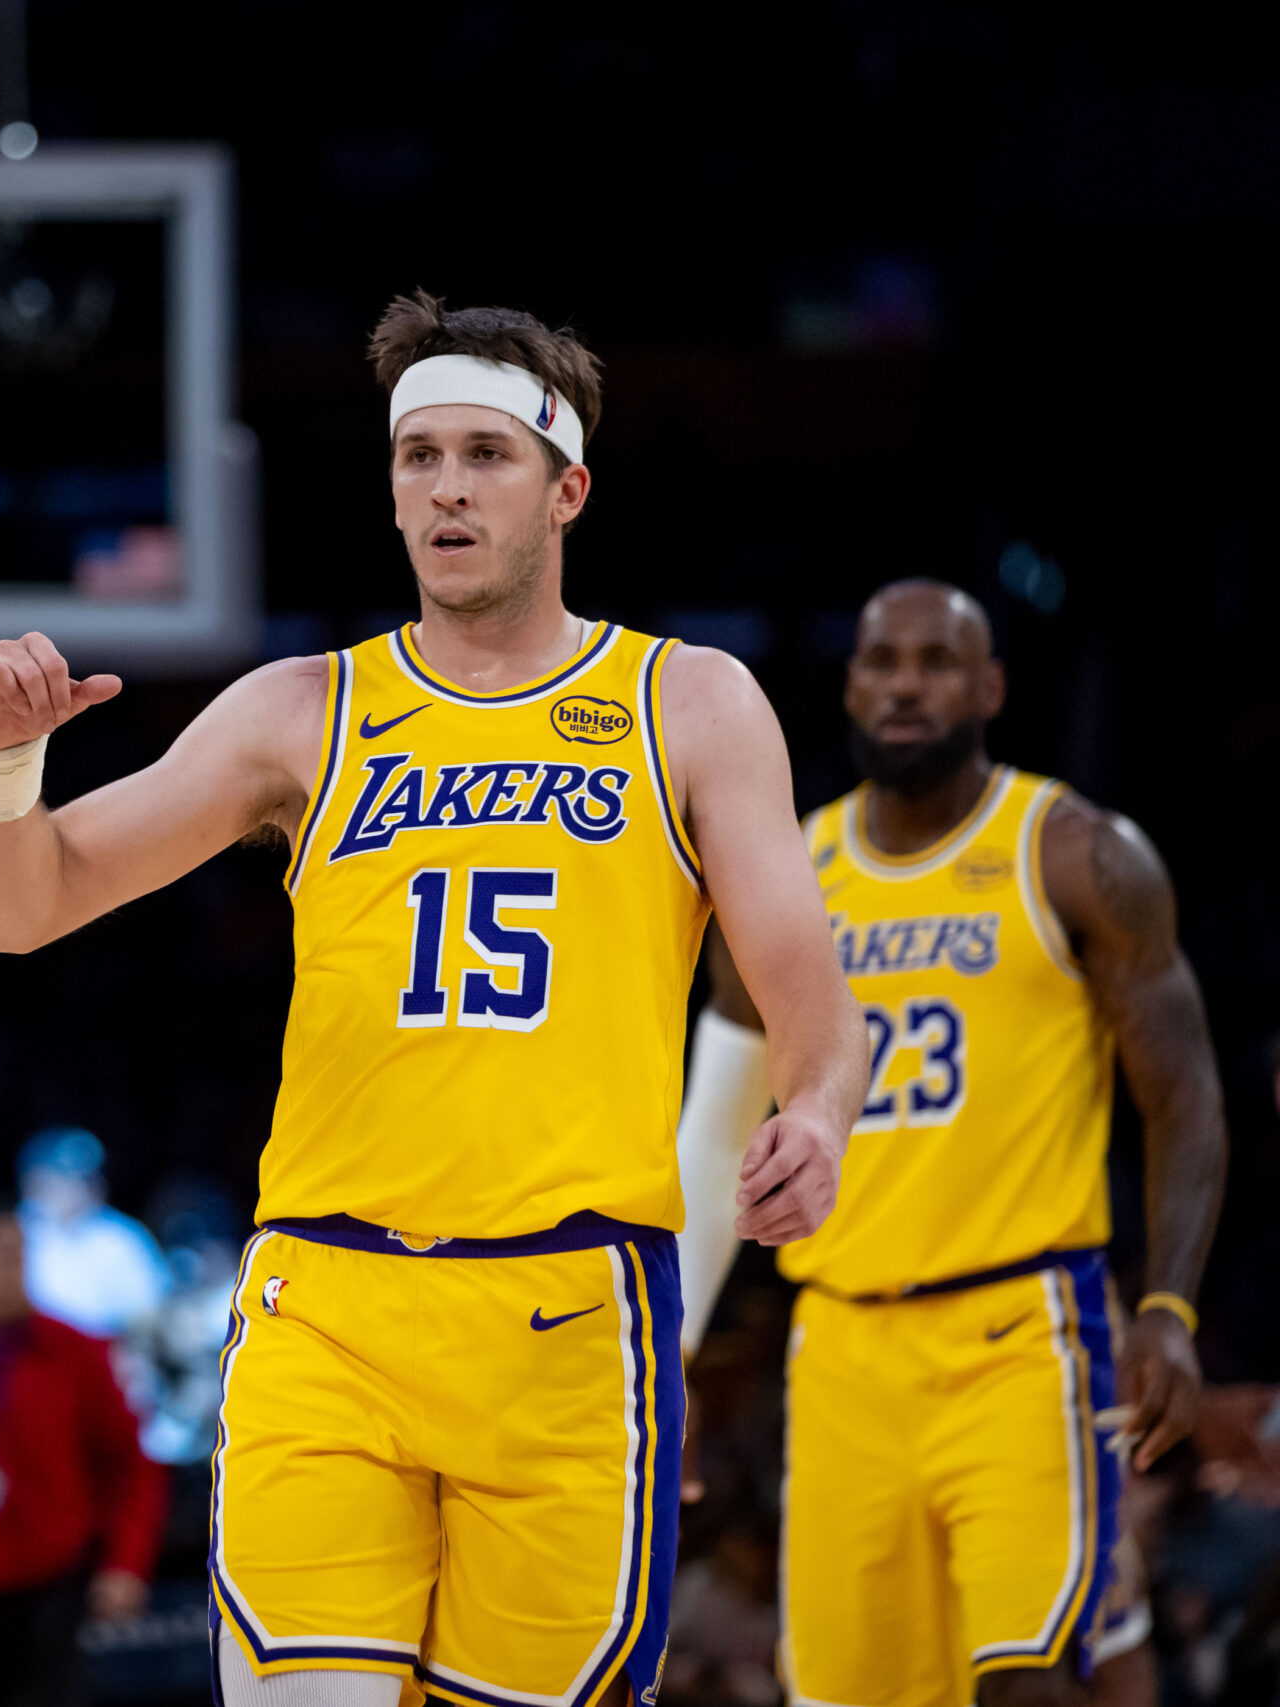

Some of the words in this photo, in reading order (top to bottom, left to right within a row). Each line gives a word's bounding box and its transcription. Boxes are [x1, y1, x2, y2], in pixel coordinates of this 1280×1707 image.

[558, 706, 628, 733] bibigo
[569, 723, 599, 735] 비비고
[326, 751, 634, 866] LAKERS
[396, 867, 559, 1033] 15
[830, 910, 1002, 979] AKERS
[851, 996, 968, 1135] 23
